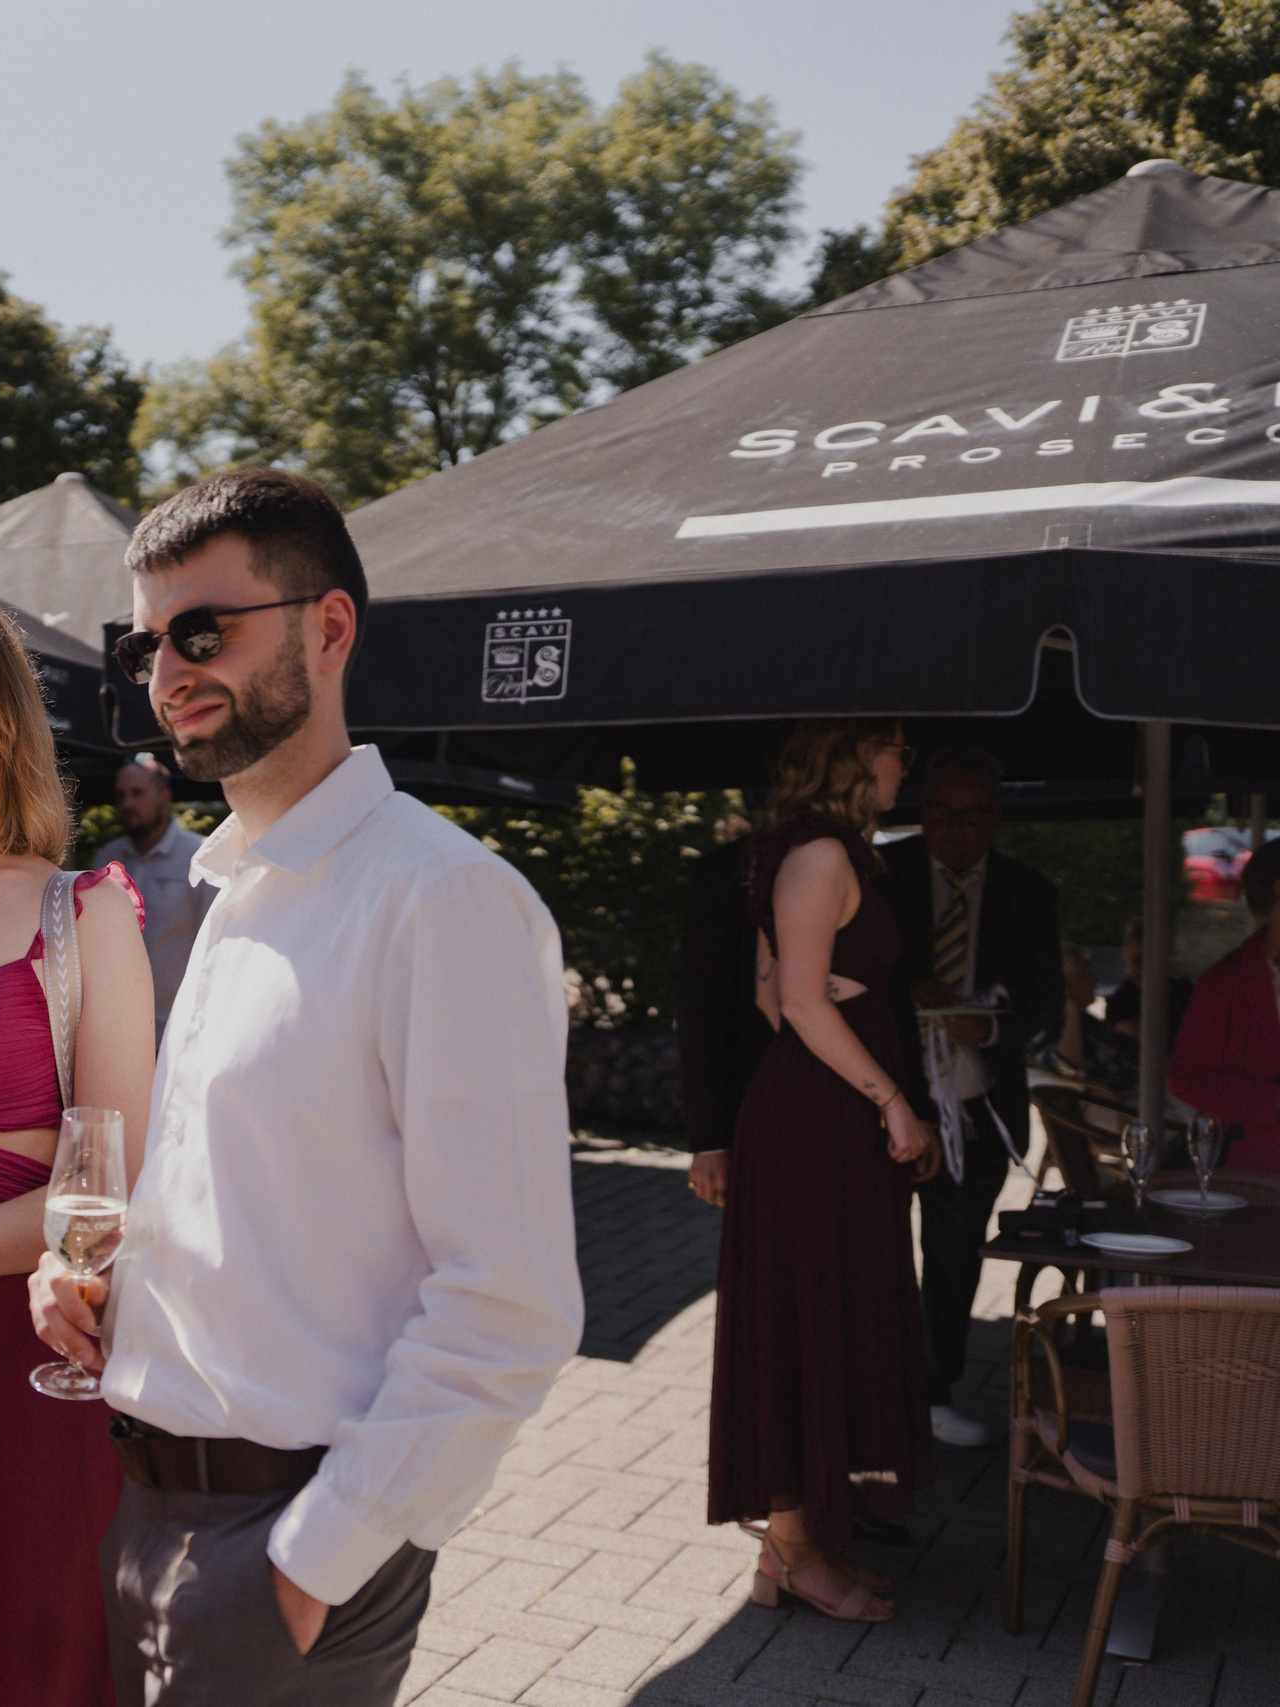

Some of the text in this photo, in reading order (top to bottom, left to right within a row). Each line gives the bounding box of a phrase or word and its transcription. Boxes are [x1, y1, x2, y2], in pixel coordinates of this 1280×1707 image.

[729, 395, 1101, 459] SCAVI
[1138, 383, 1232, 420] &
[495, 625, 564, 637] SCAVI
